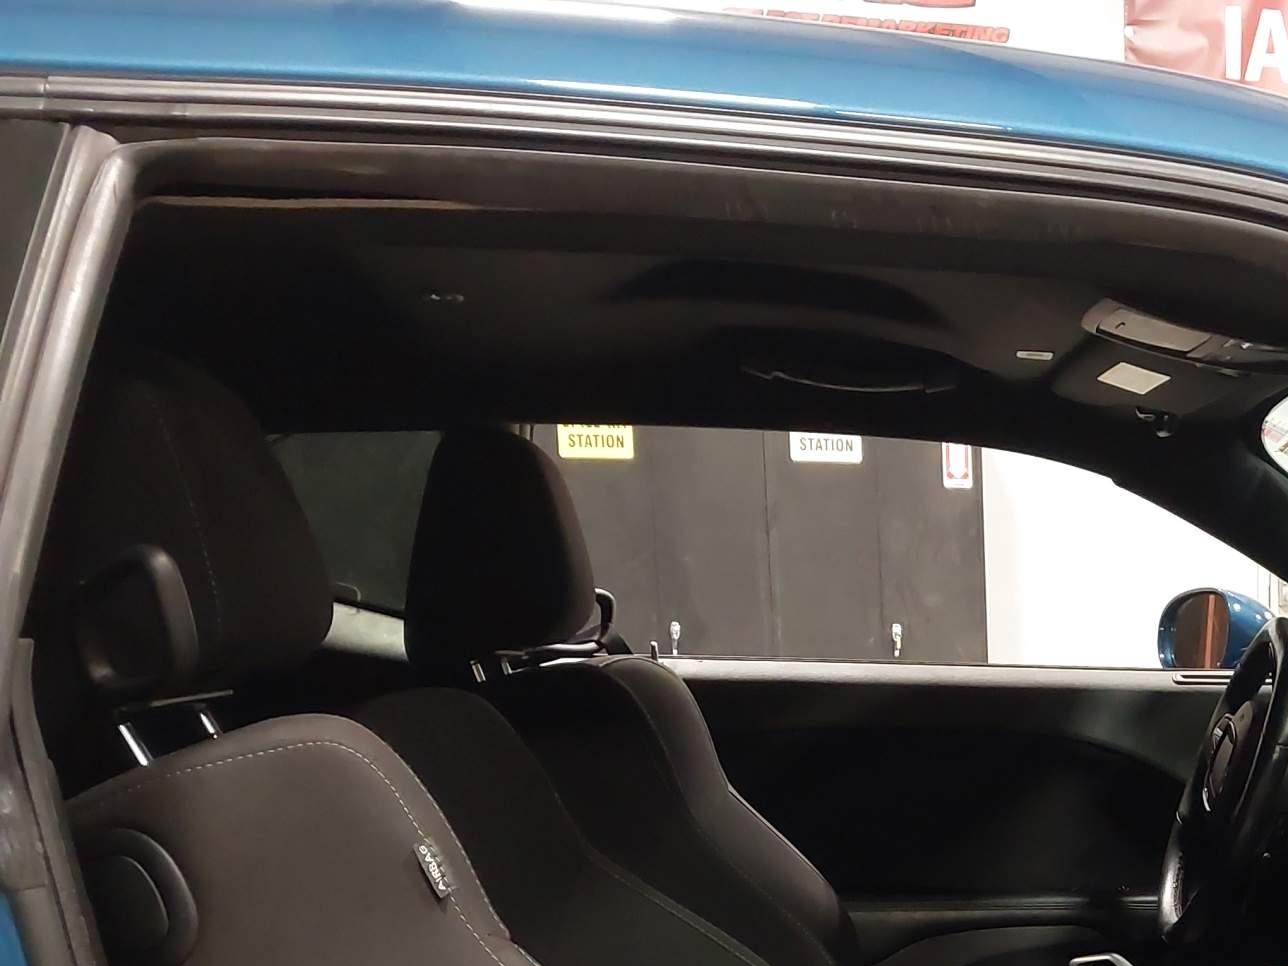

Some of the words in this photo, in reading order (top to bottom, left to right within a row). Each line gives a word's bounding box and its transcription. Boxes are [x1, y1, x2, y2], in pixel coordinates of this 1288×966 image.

[568, 434, 625, 448] STATION
[799, 437, 854, 452] STATION
[418, 844, 447, 891] AIRBAG
